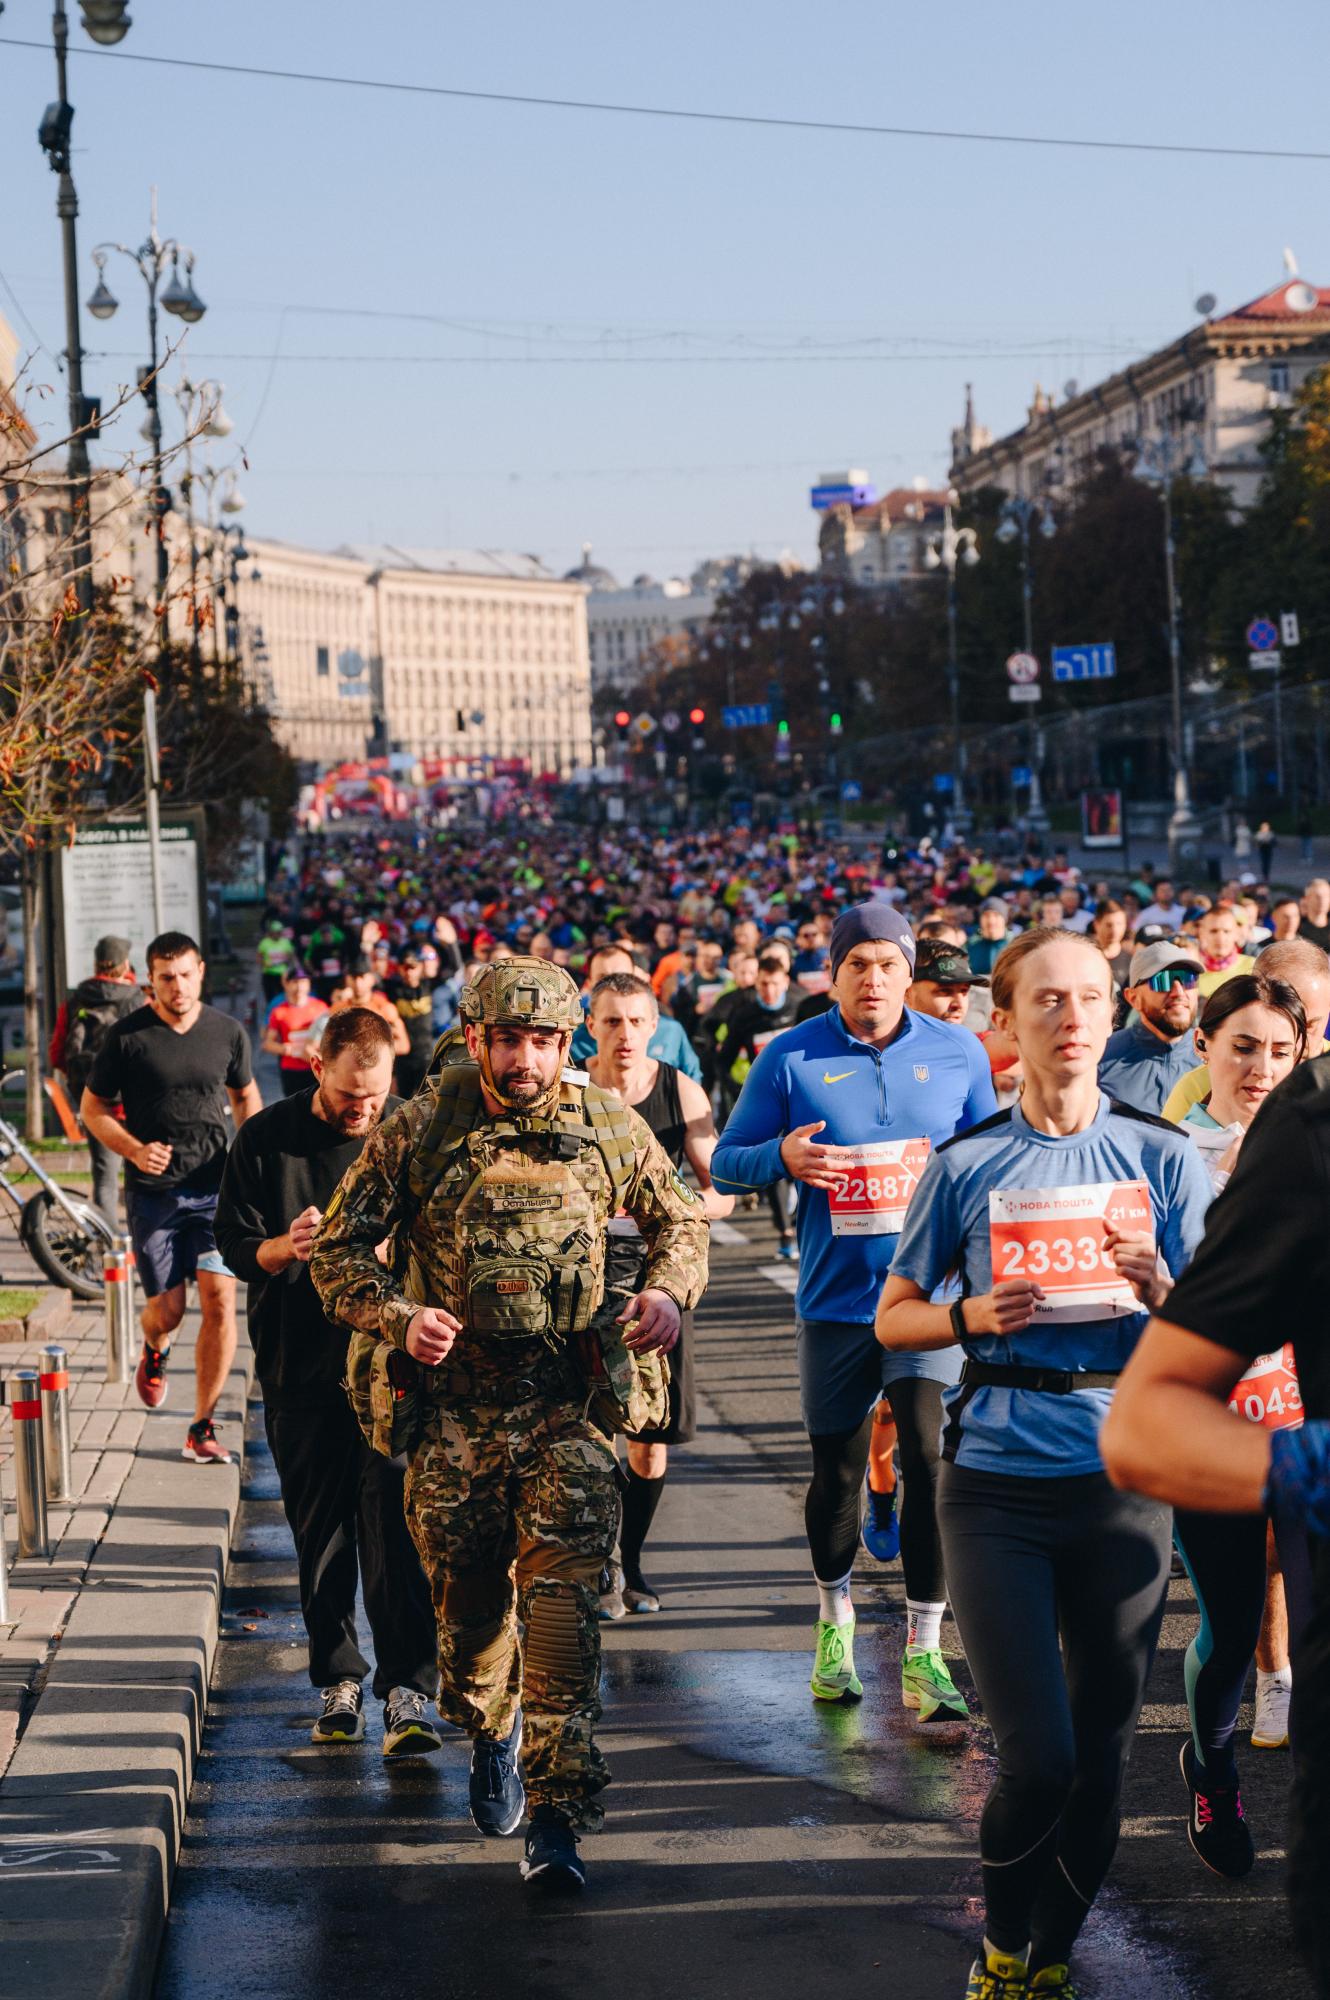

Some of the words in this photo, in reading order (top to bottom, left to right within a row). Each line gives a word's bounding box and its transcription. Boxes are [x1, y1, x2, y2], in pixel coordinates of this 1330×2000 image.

[904, 1155, 916, 1165] 21
[835, 1174, 913, 1202] 22887
[502, 1199, 552, 1209] Остальцев
[1020, 1201, 1051, 1210] НОВА
[1054, 1198, 1094, 1210] ПОШТА
[1111, 1207, 1126, 1220] 21
[844, 1219, 869, 1229] NewRun
